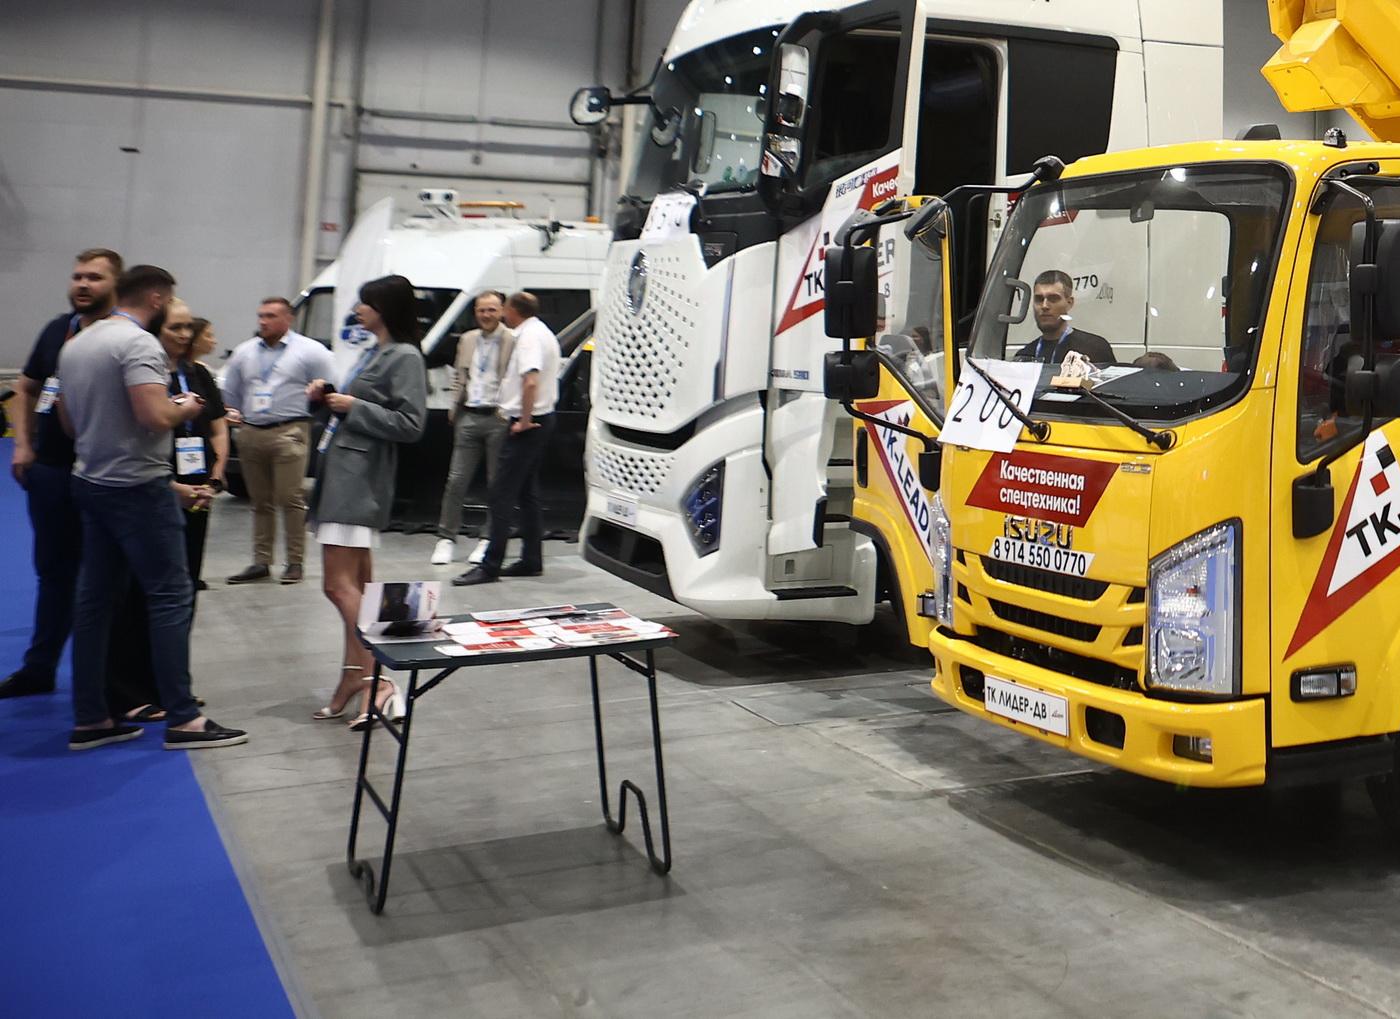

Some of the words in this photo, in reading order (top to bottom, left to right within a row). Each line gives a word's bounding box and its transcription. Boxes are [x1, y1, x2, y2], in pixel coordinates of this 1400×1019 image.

[953, 381, 1021, 430] 200
[880, 412, 931, 546] TK-LEAD
[1000, 459, 1085, 491] Качественная
[999, 487, 1081, 515] спецтехника!
[1004, 514, 1073, 550] ISUZU
[993, 538, 1001, 559] 8
[1004, 540, 1025, 563] 914
[1028, 543, 1051, 569] 550
[1054, 548, 1086, 576] 0770
[998, 690, 1047, 720] ЛИДЕР-ДВ
